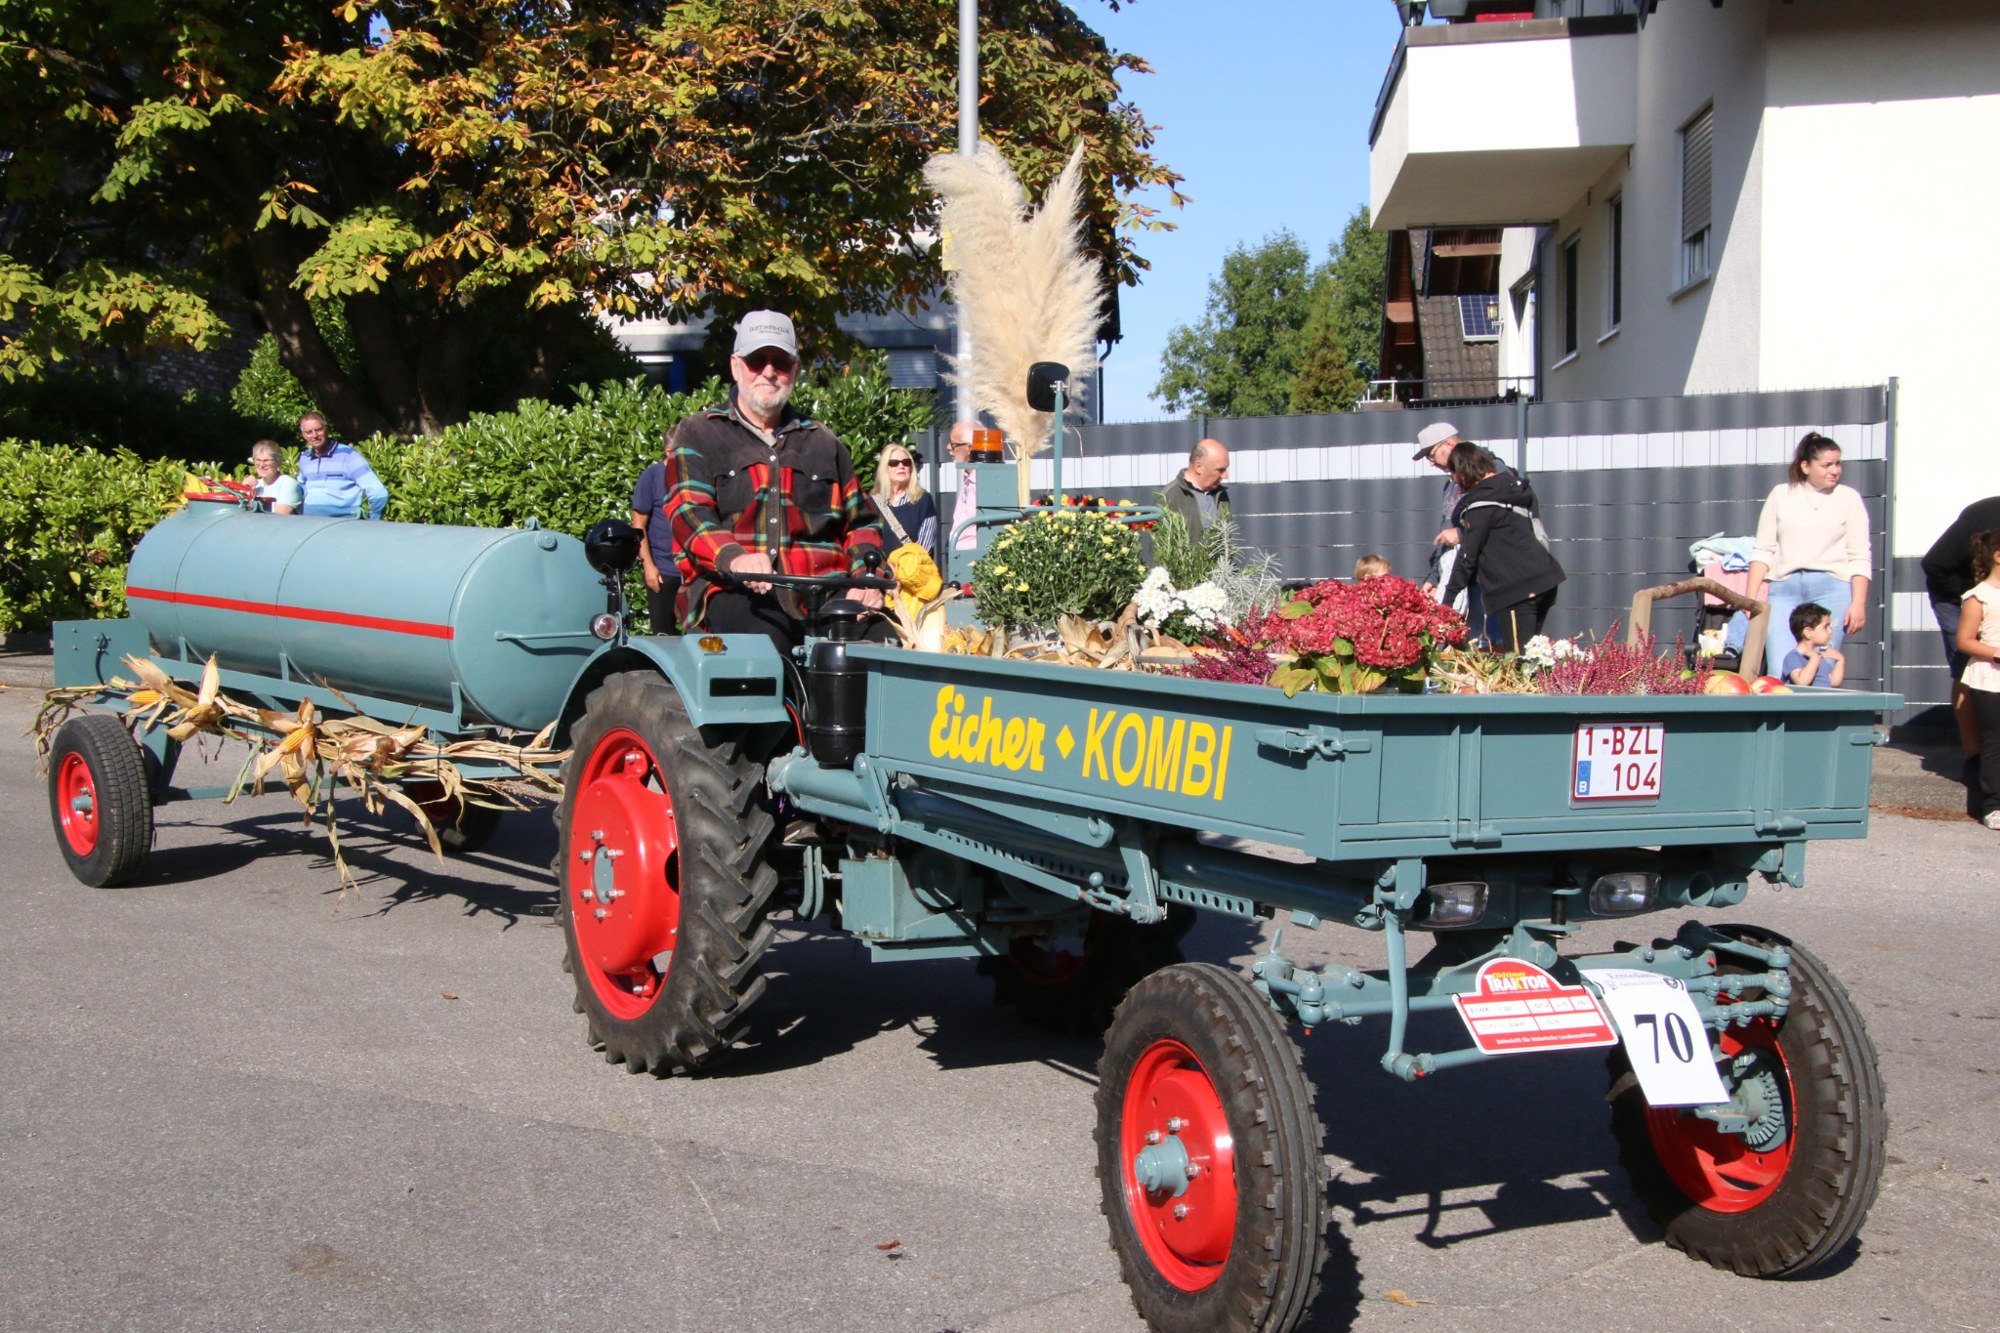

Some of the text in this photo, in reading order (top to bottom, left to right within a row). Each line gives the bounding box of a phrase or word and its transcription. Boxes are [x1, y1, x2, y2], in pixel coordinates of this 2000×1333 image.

[929, 684, 1233, 801] Eicher KOMBI
[1579, 781, 1588, 793] B
[1613, 762, 1657, 792] 104
[1483, 974, 1551, 992] TRAKTOR
[1634, 1012, 1694, 1064] 70
